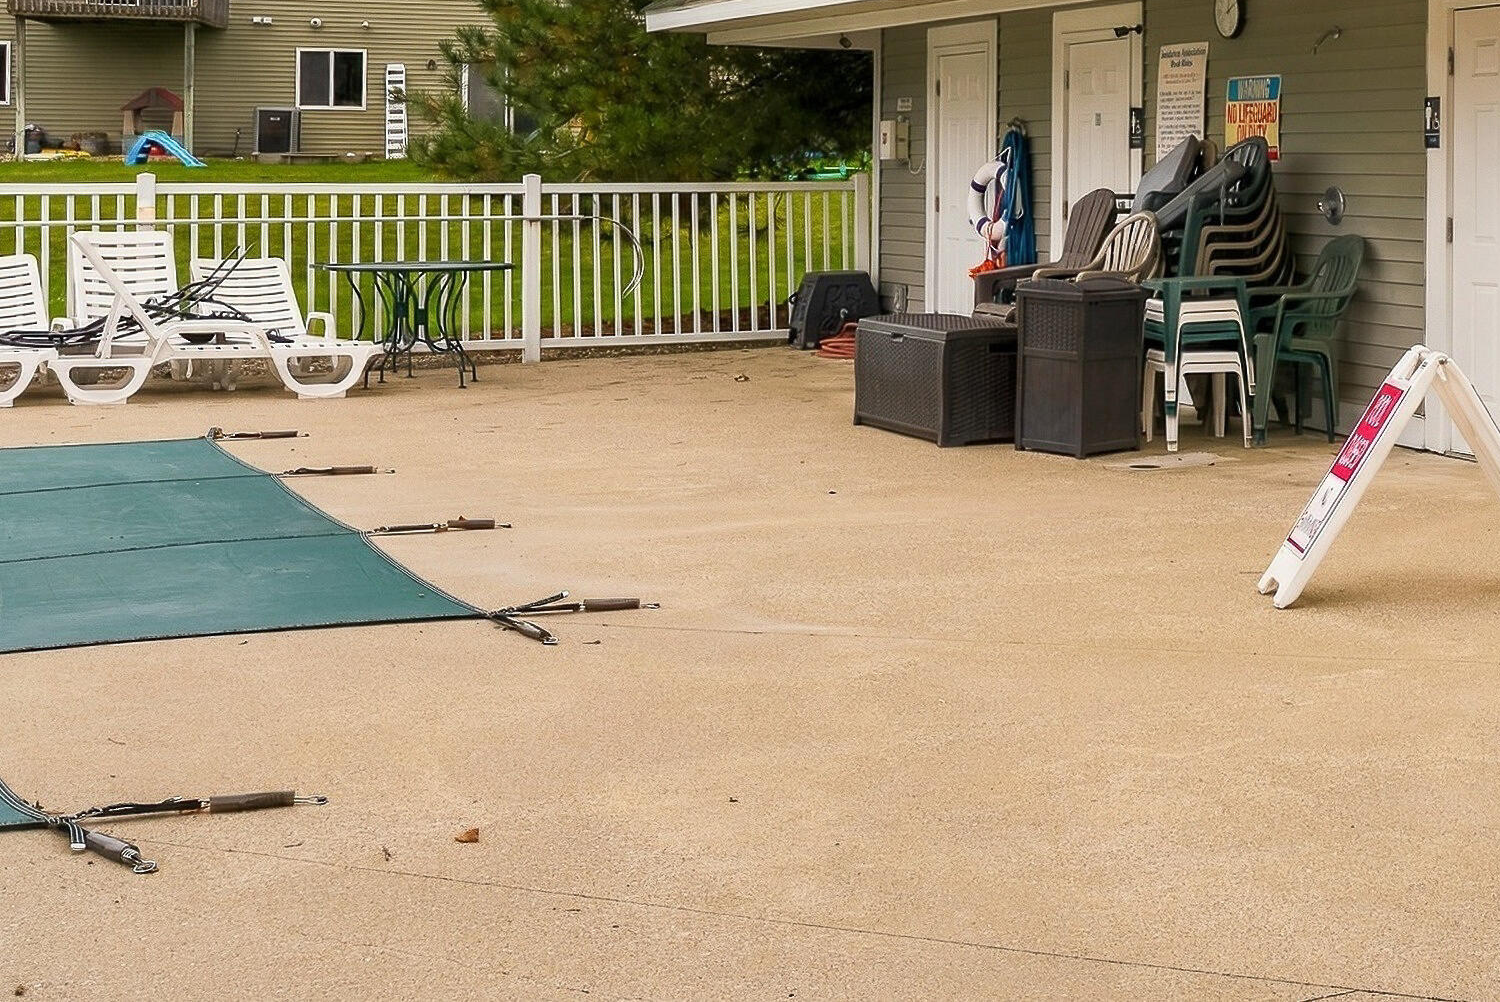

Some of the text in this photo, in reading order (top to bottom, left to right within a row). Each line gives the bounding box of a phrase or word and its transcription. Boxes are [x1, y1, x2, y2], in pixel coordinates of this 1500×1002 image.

[1238, 78, 1269, 100] WARNING
[1227, 101, 1277, 124] NO LIFEGUARD
[1365, 393, 1393, 428] POOL
